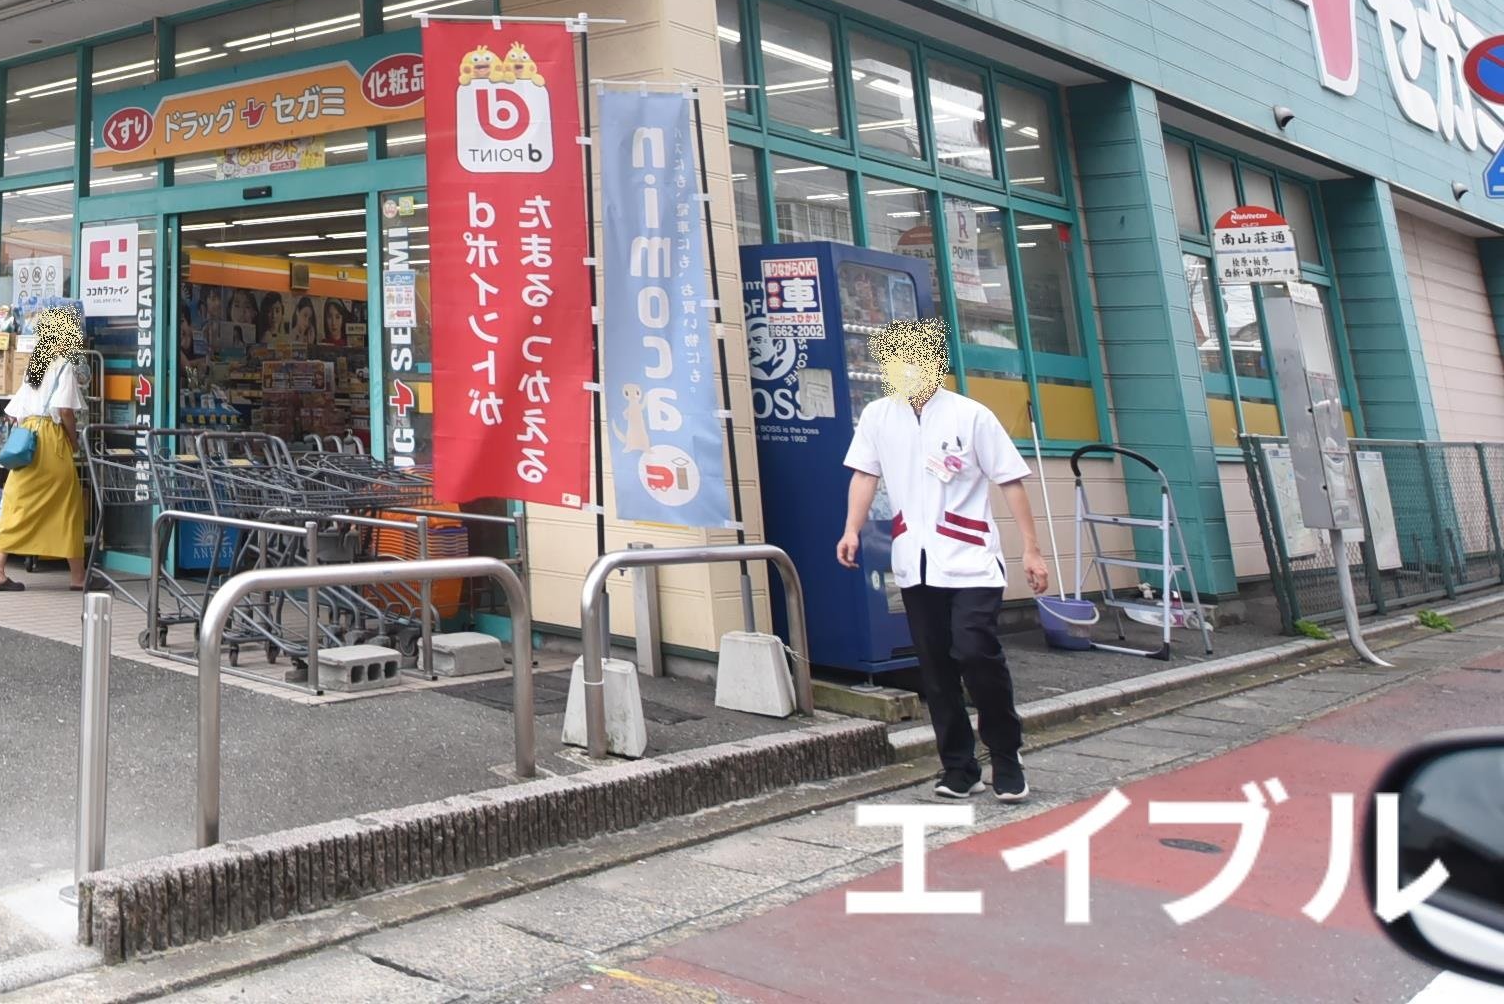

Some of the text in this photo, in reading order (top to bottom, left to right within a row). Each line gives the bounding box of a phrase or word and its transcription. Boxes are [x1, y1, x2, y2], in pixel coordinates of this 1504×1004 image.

[367, 63, 424, 100] 化粧品
[165, 99, 236, 143] ドラッグ
[272, 84, 345, 124] セガミ
[107, 114, 148, 146] くすり
[1221, 230, 1288, 246] 南山荘通
[86, 285, 130, 297] ココカラファイン
[136, 247, 153, 369] SEGAMI
[388, 226, 413, 371] SEMI
